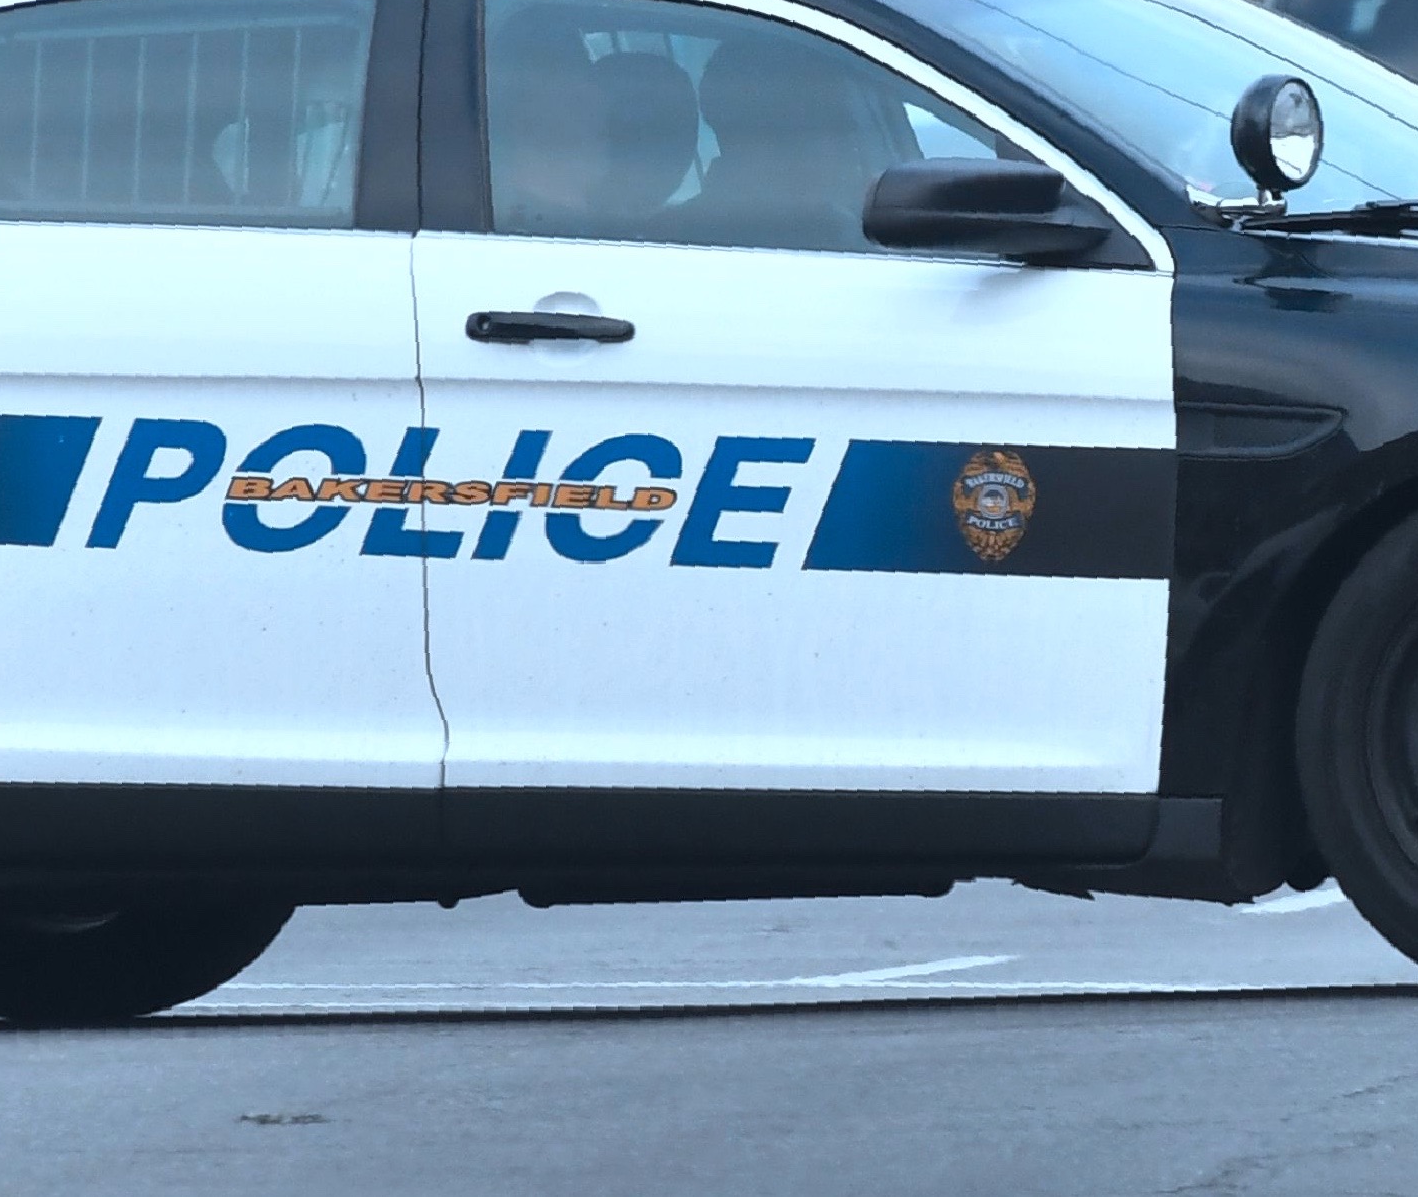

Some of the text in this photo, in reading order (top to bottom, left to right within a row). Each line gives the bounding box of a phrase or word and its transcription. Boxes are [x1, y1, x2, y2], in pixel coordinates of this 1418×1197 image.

[86, 417, 815, 568] POLICE
[224, 476, 678, 511] BAKERSFIELD
[967, 515, 1018, 530] POLICE
